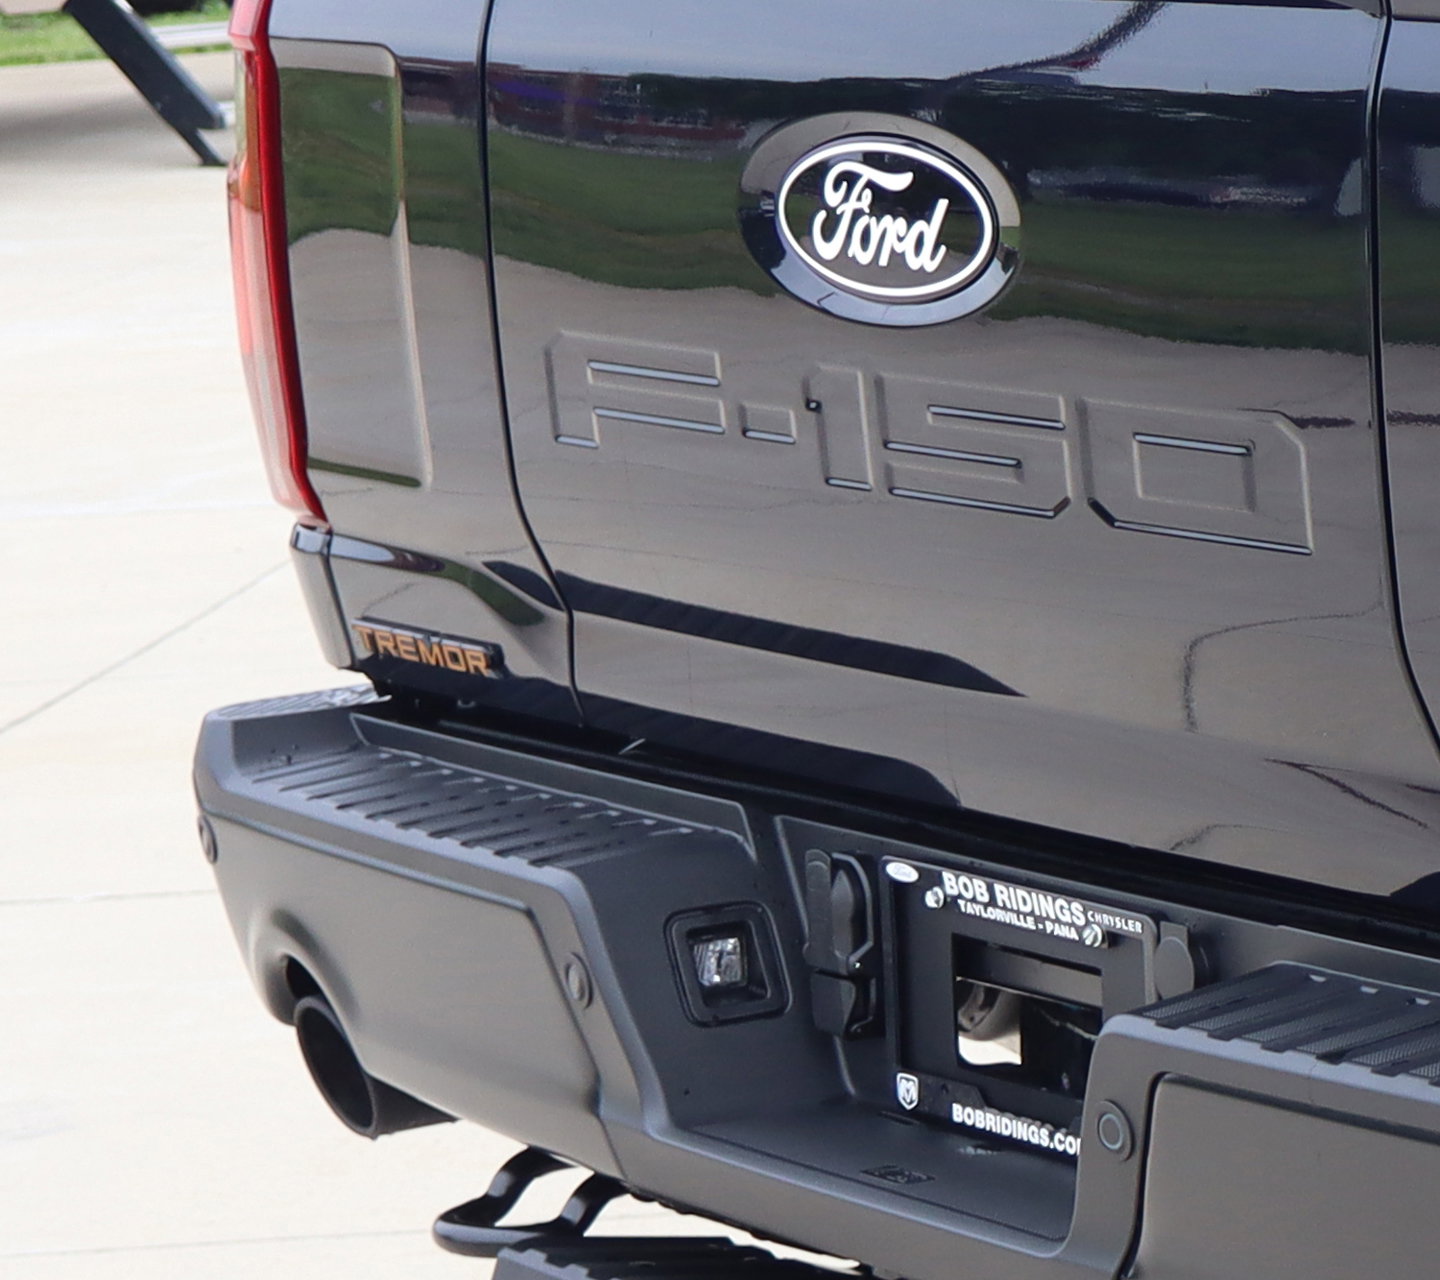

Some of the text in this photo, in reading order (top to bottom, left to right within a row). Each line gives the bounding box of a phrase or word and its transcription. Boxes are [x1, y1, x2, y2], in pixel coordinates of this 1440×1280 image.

[812, 159, 950, 273] Ford
[544, 328, 1315, 557] F-150
[351, 623, 495, 677] TREMOR
[941, 870, 1087, 926] BOB RIDINGS
[957, 898, 1036, 931] TAYLORVILLE
[1045, 921, 1080, 941] PANA
[1087, 911, 1143, 934] CHRYSLER
